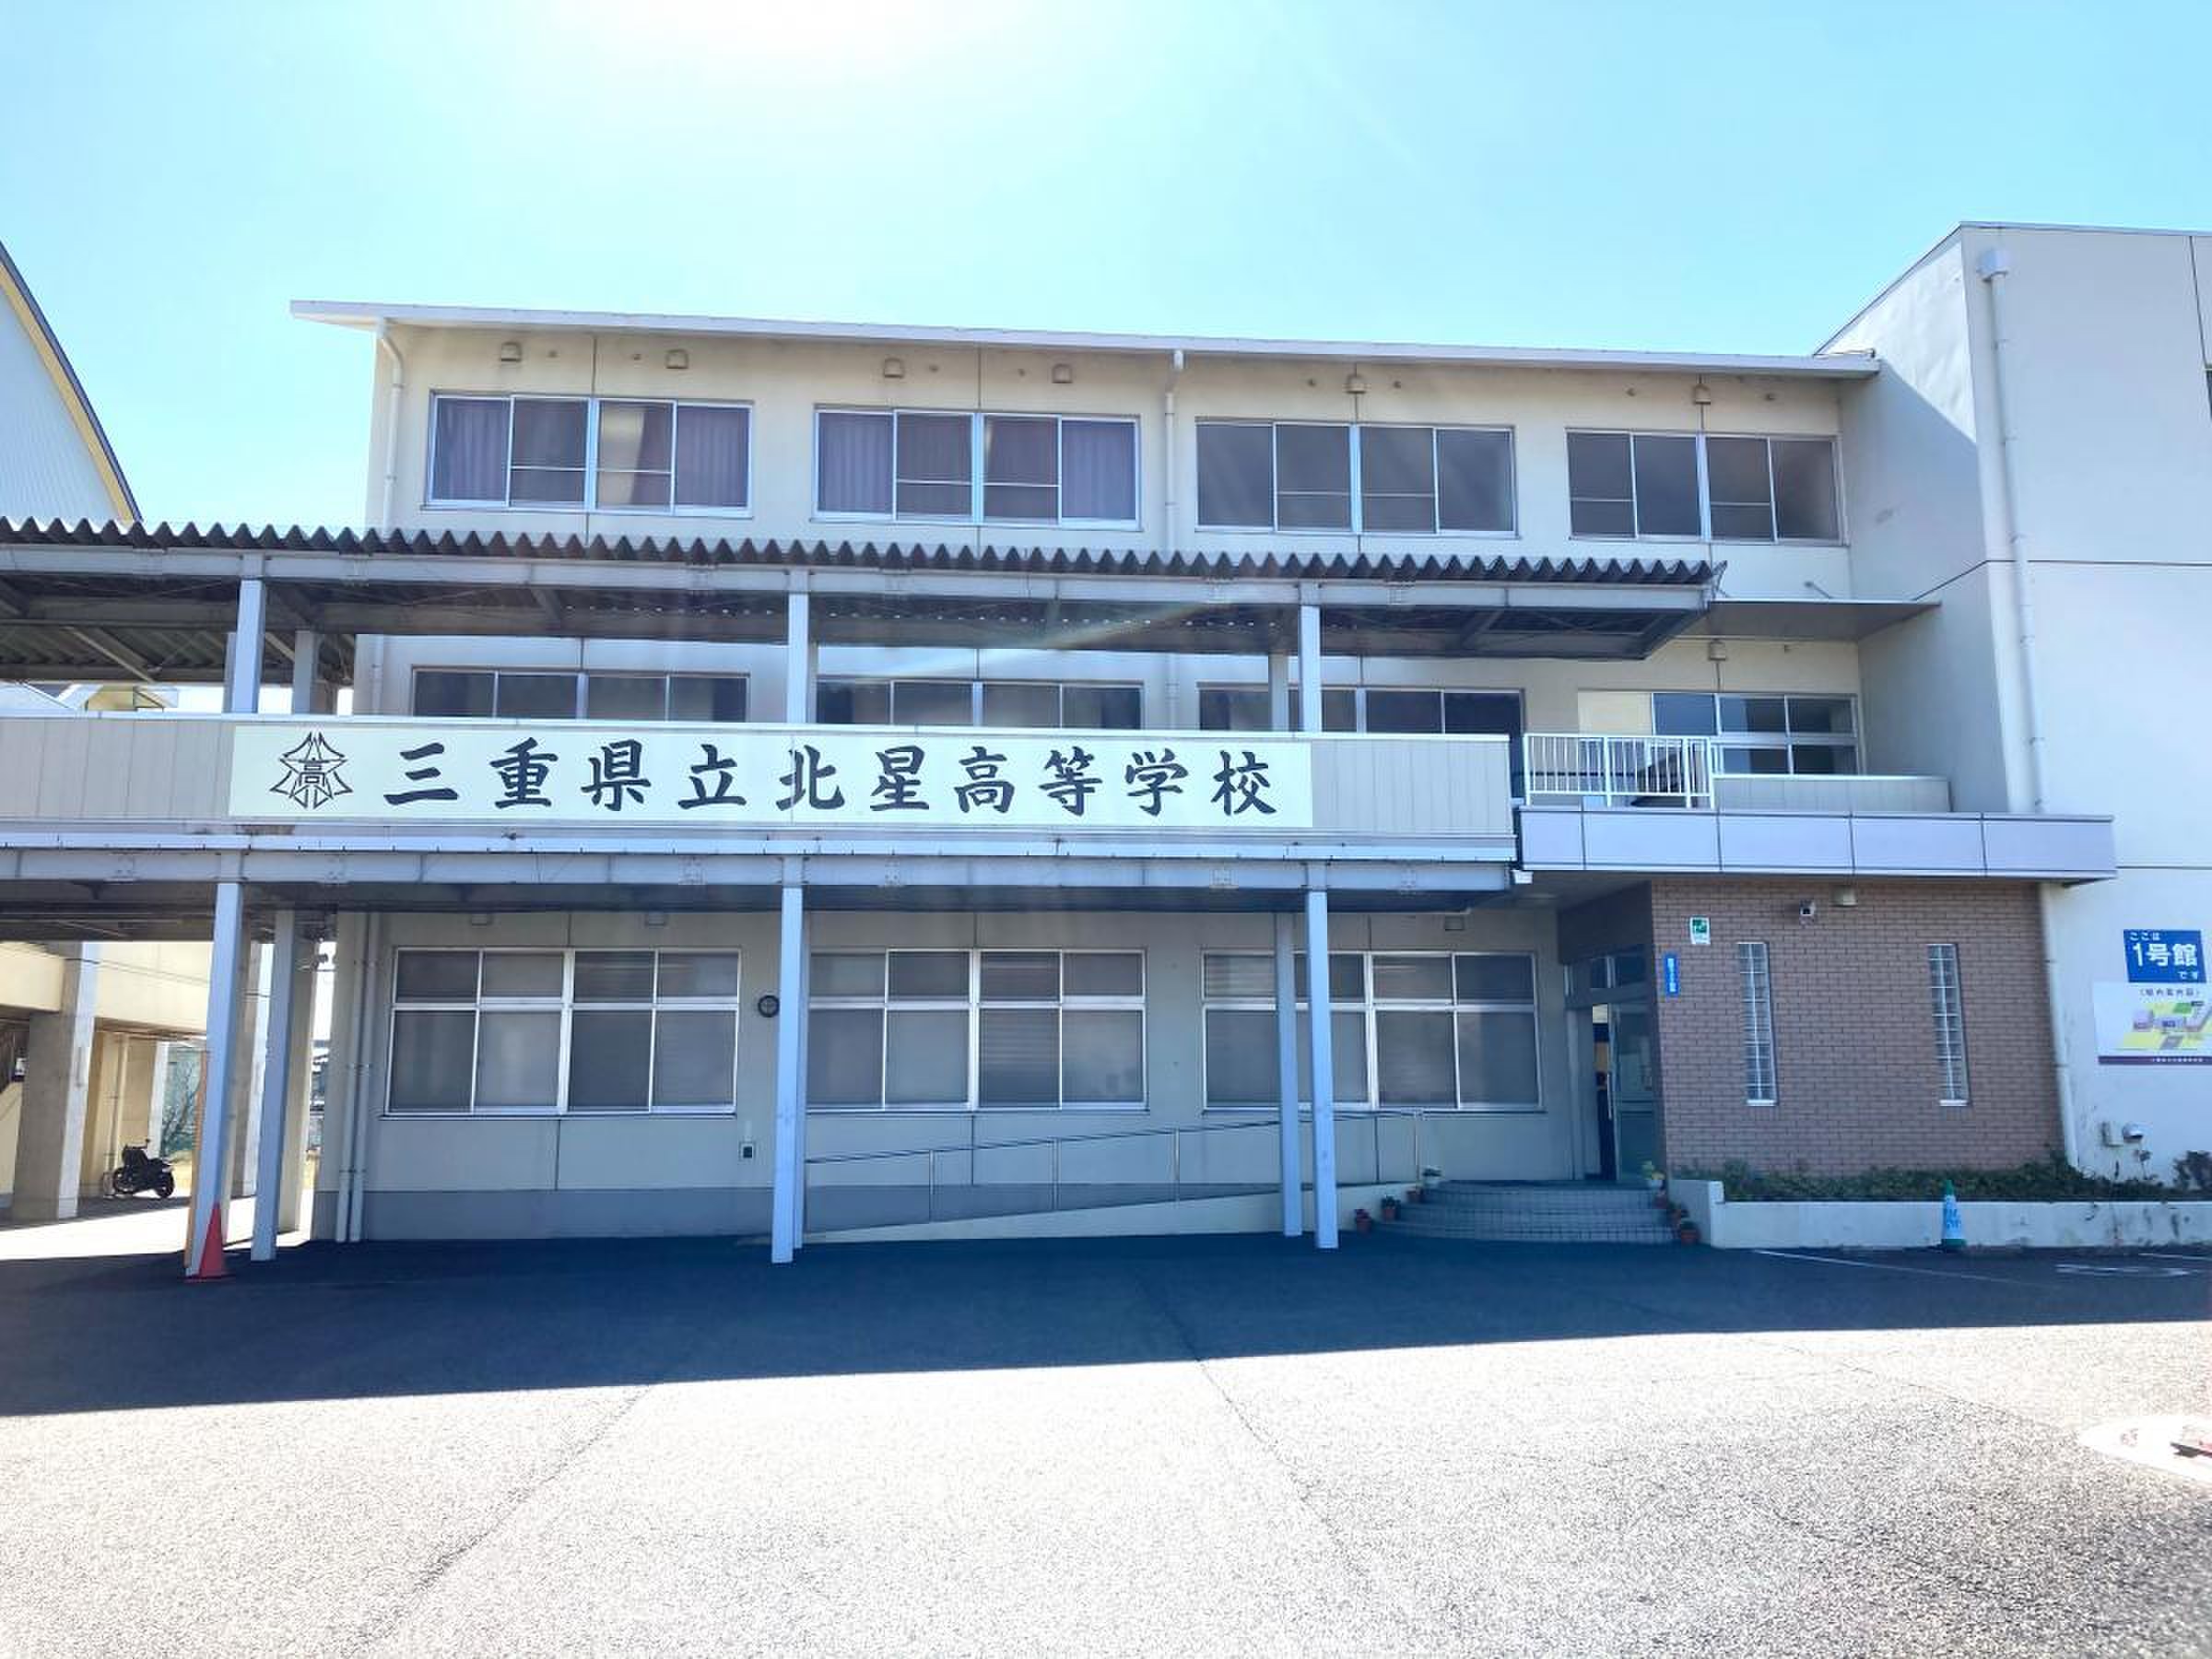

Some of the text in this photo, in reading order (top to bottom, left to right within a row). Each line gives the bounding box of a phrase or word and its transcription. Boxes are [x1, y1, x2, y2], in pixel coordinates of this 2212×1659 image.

[383, 736, 1277, 817] 三重県立北星高等学校
[2129, 931, 2161, 941] ここは
[2132, 942, 2198, 967] 1号館
